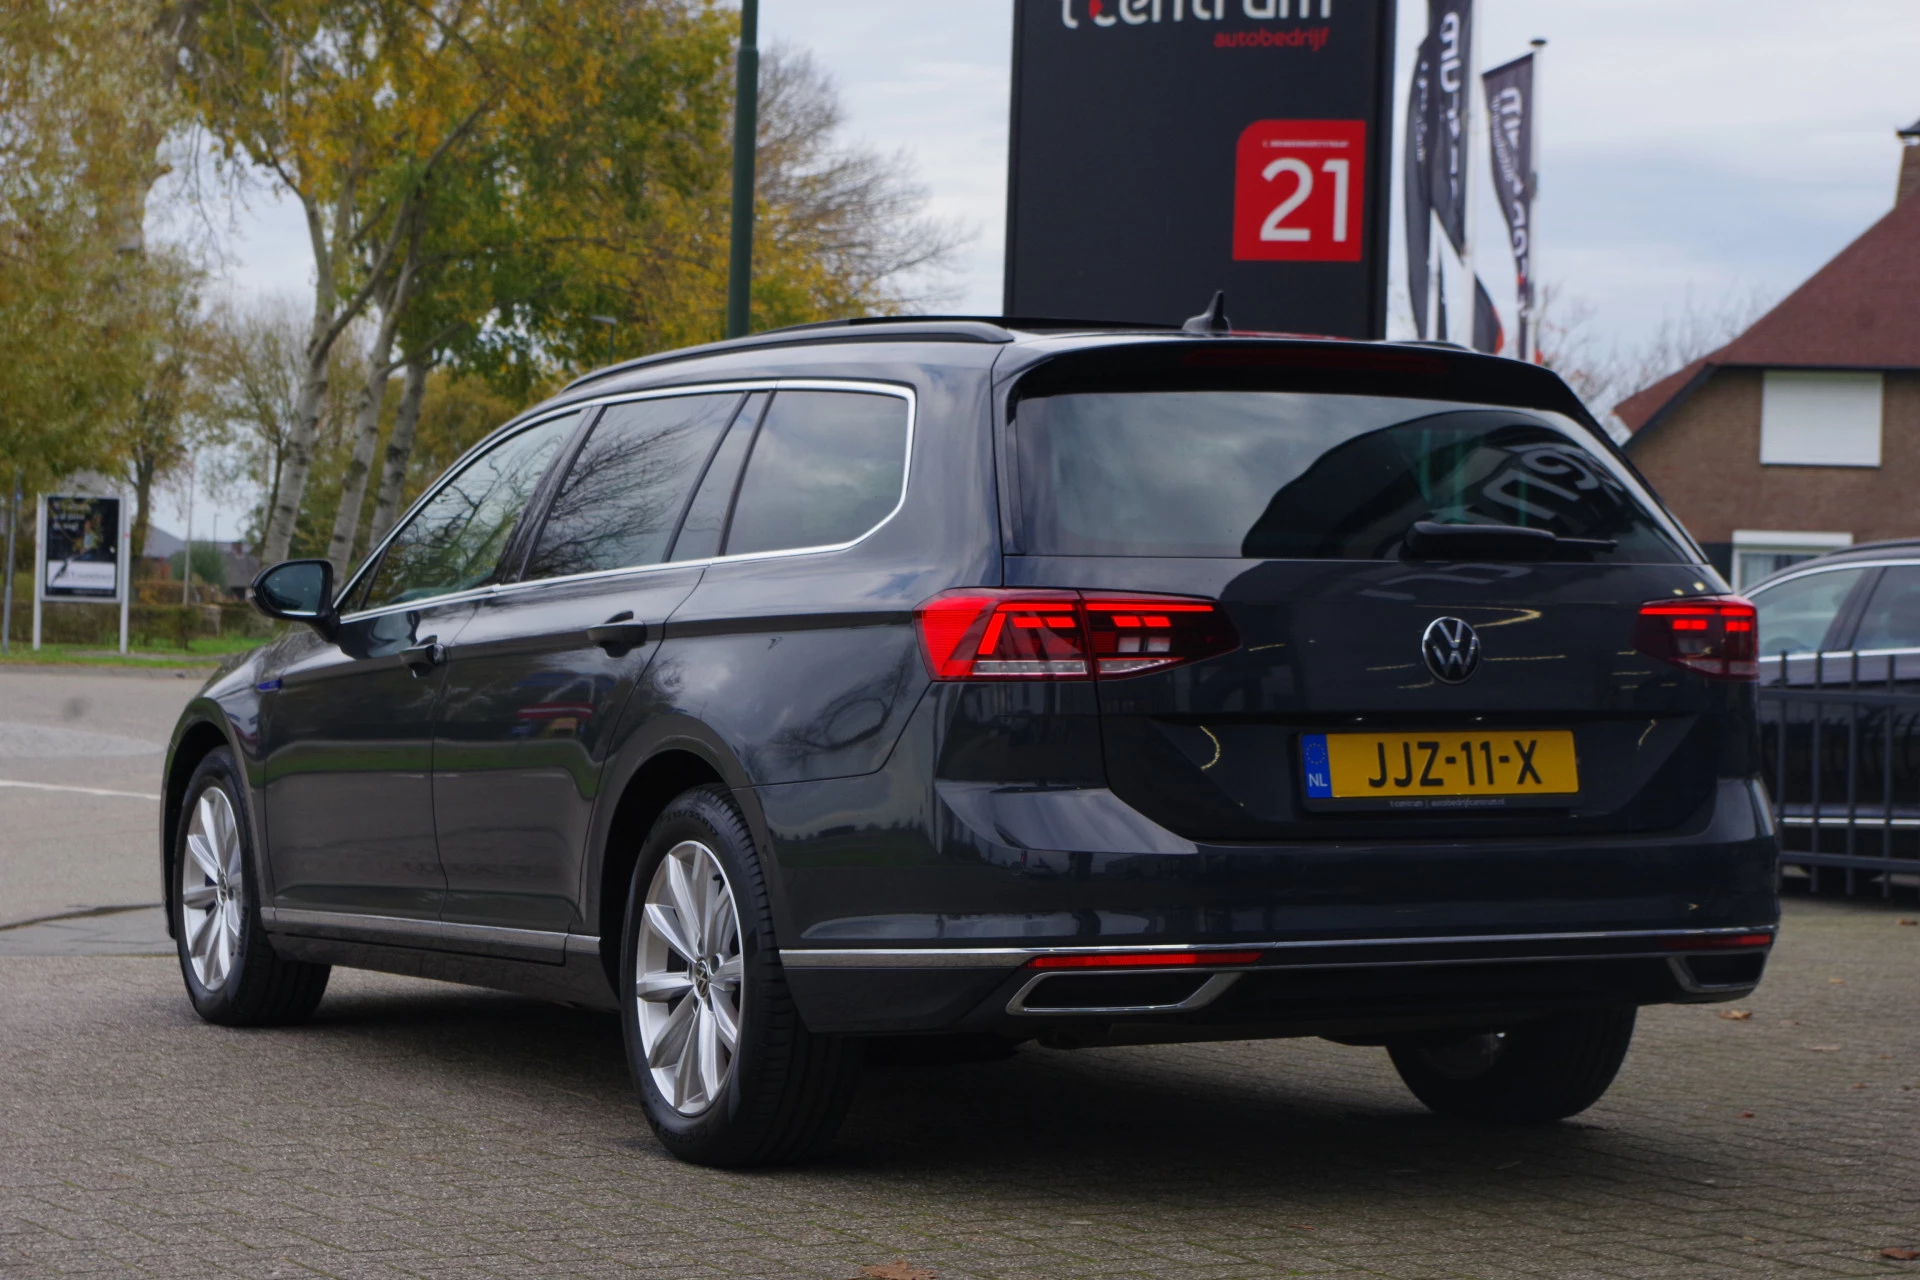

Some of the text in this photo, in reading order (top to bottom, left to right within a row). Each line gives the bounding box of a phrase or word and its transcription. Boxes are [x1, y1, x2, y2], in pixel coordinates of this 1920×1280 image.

[1213, 26, 1330, 51] autobedrijf
[1260, 157, 1349, 242] 21
[1308, 773, 1328, 787] NL
[1368, 740, 1542, 788] JJZ-11-X
